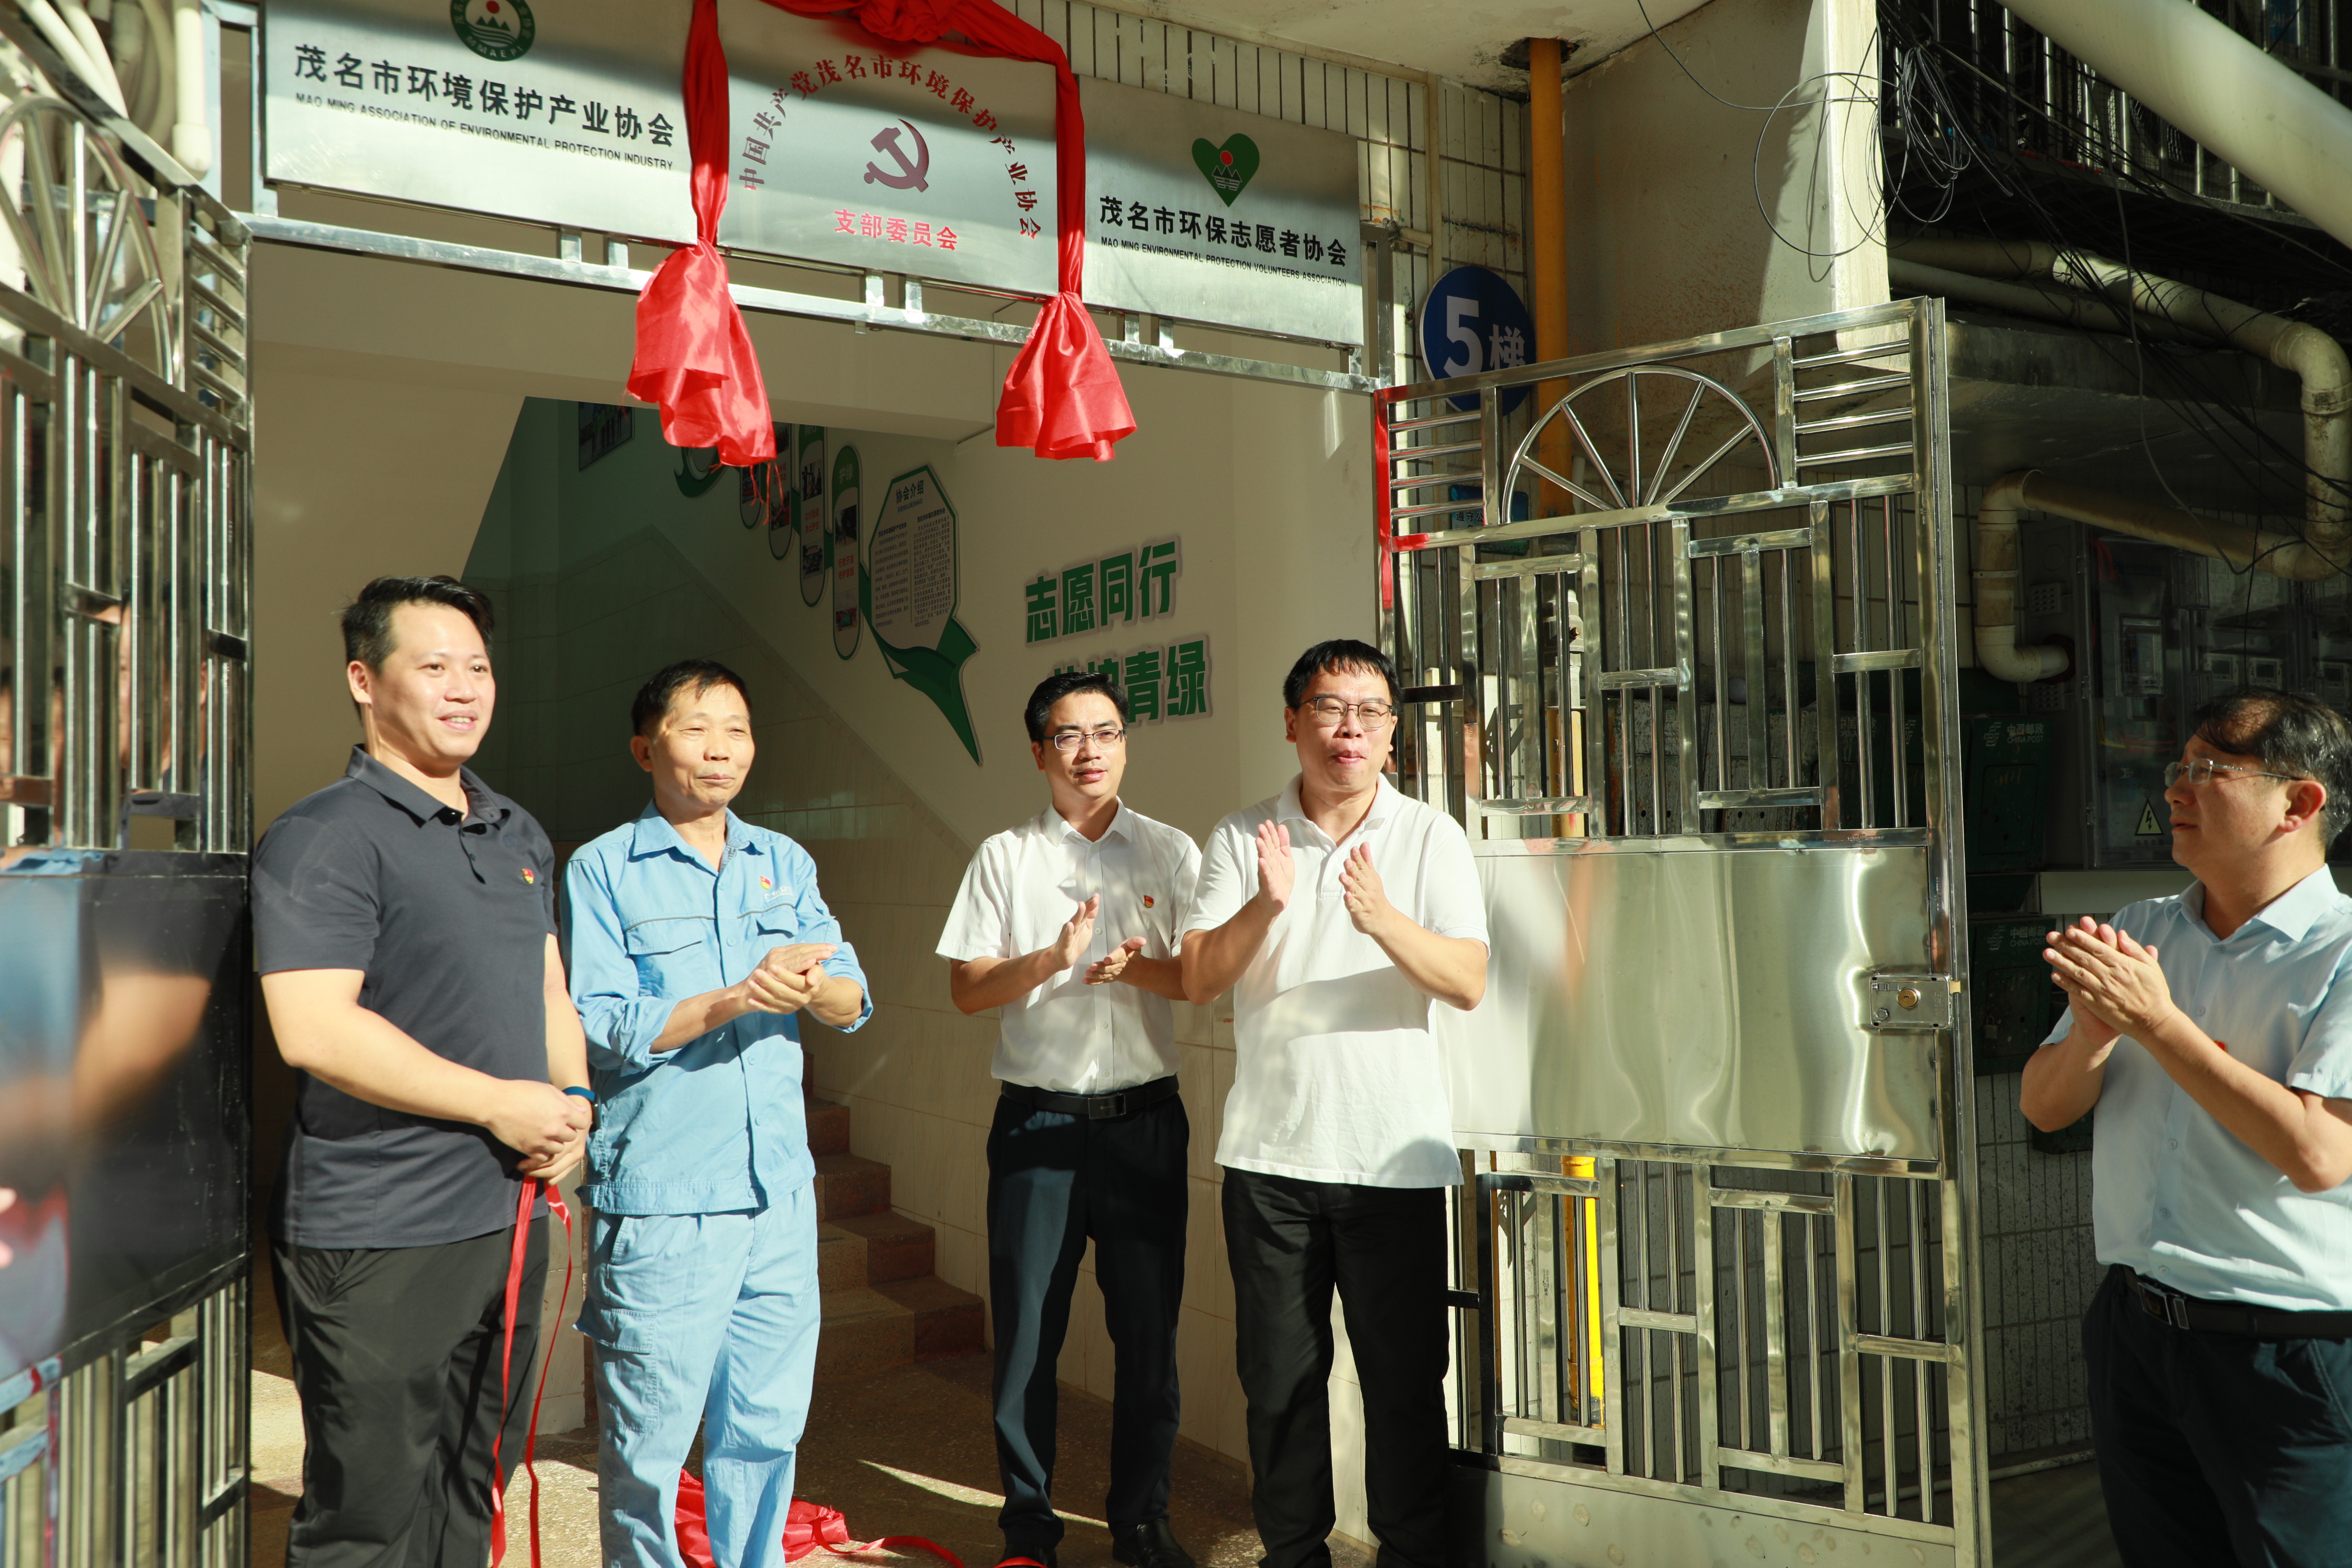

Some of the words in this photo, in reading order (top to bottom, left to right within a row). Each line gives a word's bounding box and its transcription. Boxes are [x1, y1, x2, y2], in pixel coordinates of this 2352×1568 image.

[465, 35, 524, 58] MMAEPI
[294, 44, 675, 148] 茂名市环境保护产业协会
[296, 93, 322, 107] MAO
[327, 98, 355, 114] MING
[360, 106, 437, 129] ASSOCIATION
[441, 120, 456, 131] OF
[460, 124, 551, 150] ENVIRONMENTAL
[555, 140, 621, 162] PROTECTION
[624, 152, 673, 171] INDUSTRY
[739, 54, 1042, 240] 中国共产党茂名市环境保护产业协会
[834, 208, 959, 252] 支部委员会
[1100, 195, 1347, 267] 茂名市环保志愿者协会
[1101, 237, 1118, 248] MAO
[1121, 240, 1140, 251] MING
[1142, 243, 1203, 263] ENVIRONMENTAL
[1206, 254, 1251, 271] PROTECTION
[1254, 262, 1300, 280] VOLUNTEERS
[1302, 272, 1347, 288] ASSOCIATION
[896, 479, 924, 504] 协会介绍
[897, 498, 923, 513] XIEHUIJIESHAO
[1025, 541, 1177, 643] 志愿同行
[2006, 723, 2044, 737] 中国邮政
[2010, 925, 2046, 939] 中国邮政
